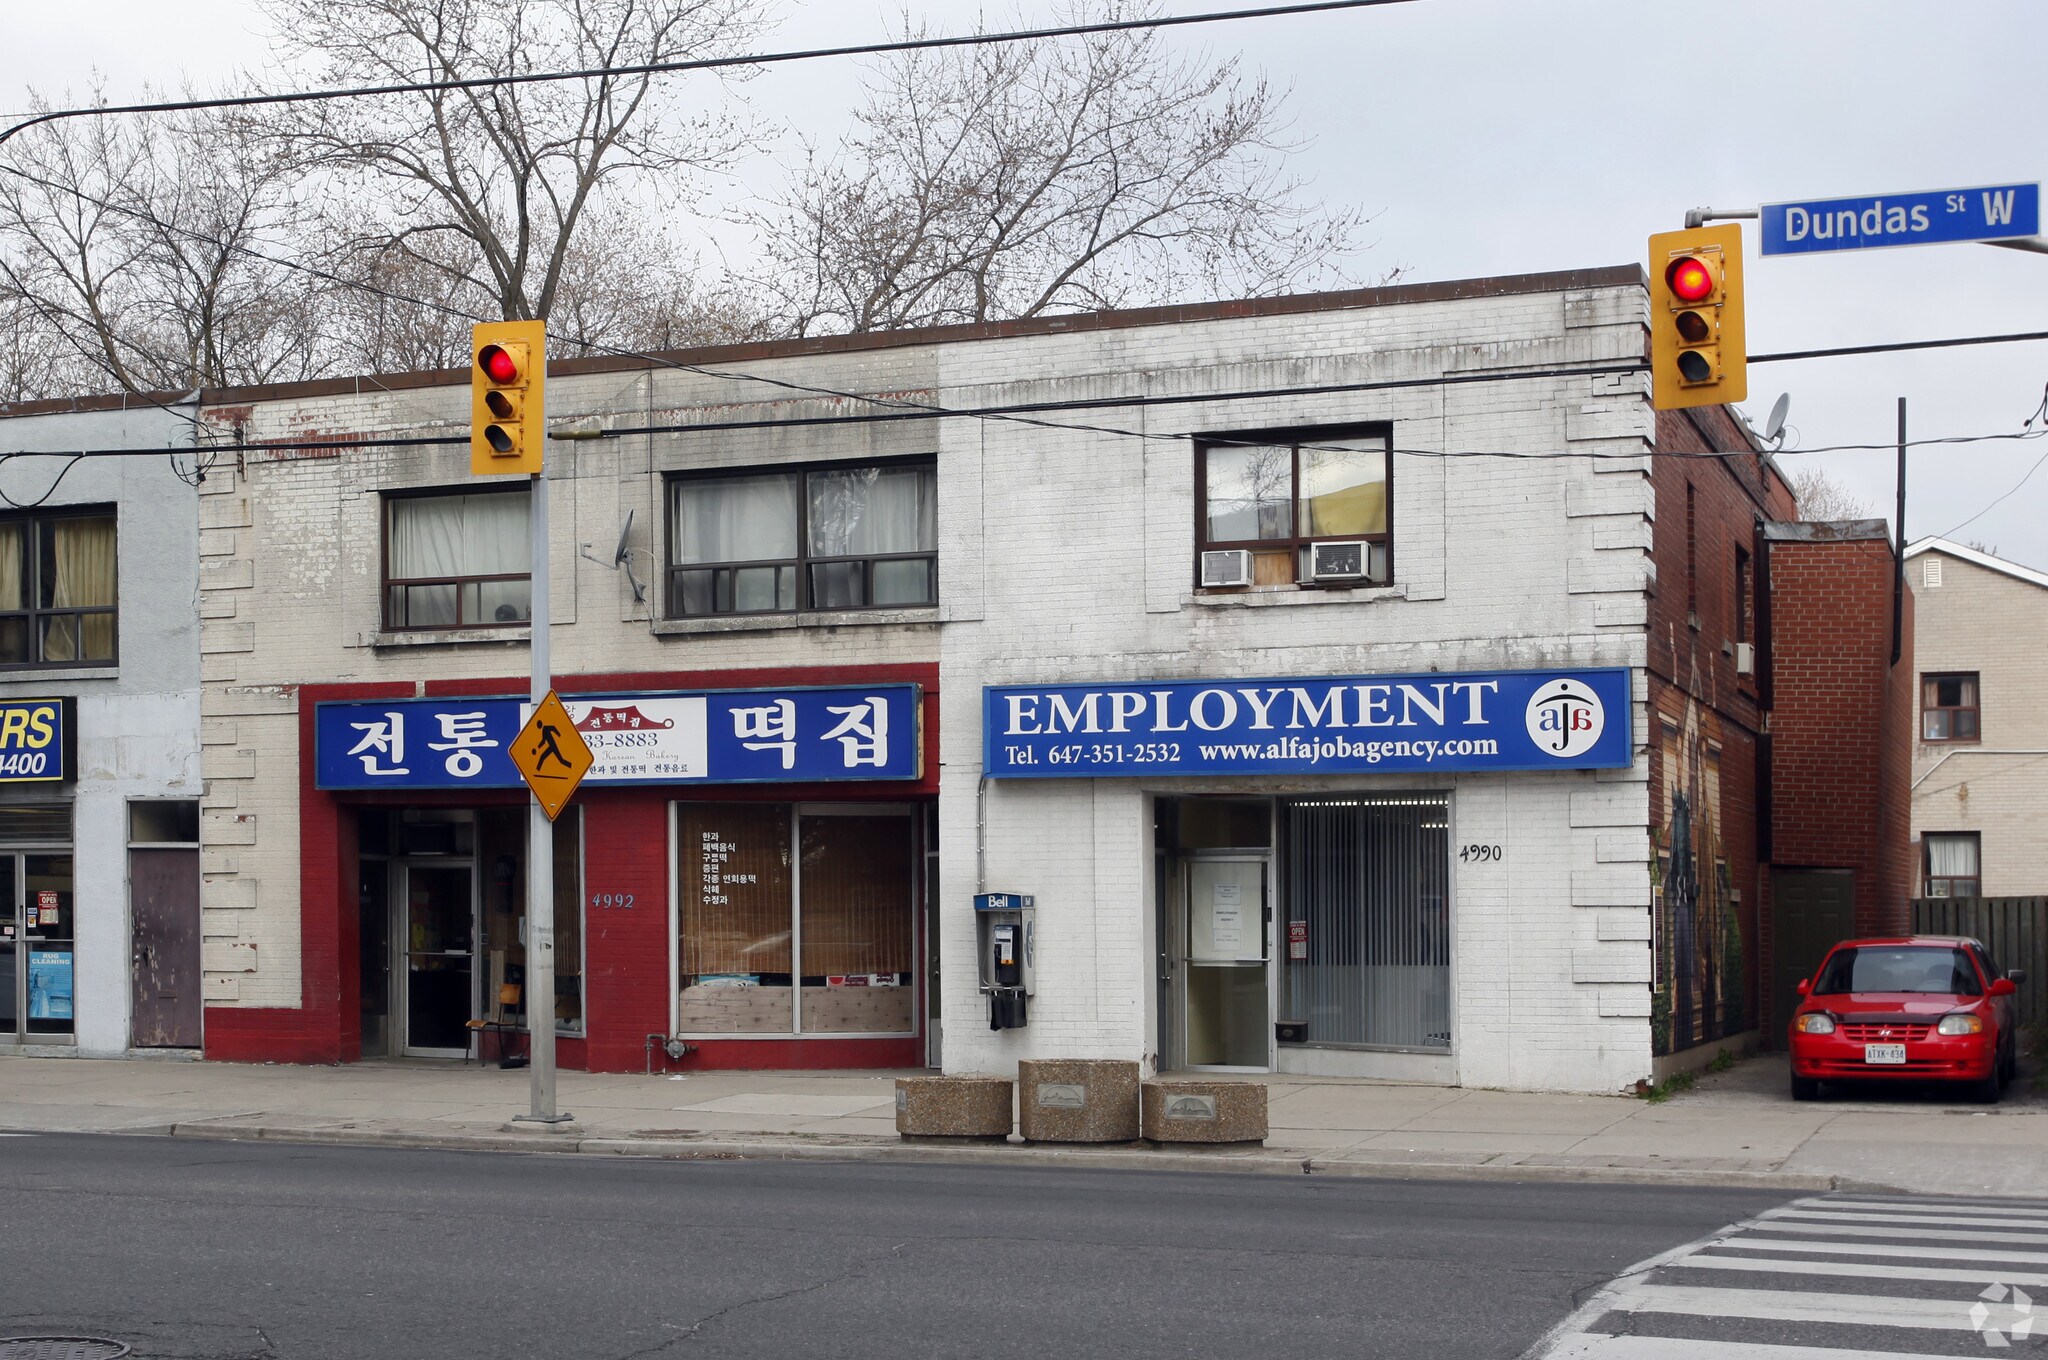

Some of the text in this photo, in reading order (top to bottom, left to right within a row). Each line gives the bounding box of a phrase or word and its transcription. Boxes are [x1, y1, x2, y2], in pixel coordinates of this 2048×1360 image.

[1785, 189, 2015, 242] Dundas St W
[1003, 680, 1499, 736] EMPLOYMENT
[0, 706, 55, 749] RS
[347, 696, 889, 777] 전통 떡집
[602, 749, 680, 762] Korean Bakery
[1005, 736, 1499, 765] Tel. 647-351-2532 www.alfajobagency.com
[702, 831, 719, 842] 한과
[702, 853, 728, 863] 구름떡
[1459, 844, 1502, 863] 4990
[702, 874, 719, 884] 각종
[41, 896, 57, 904] OPEN
[592, 893, 634, 909] 4992
[702, 895, 728, 905] 수정과
[988, 895, 1009, 908] Bell
[1291, 927, 1305, 936] OPEN
